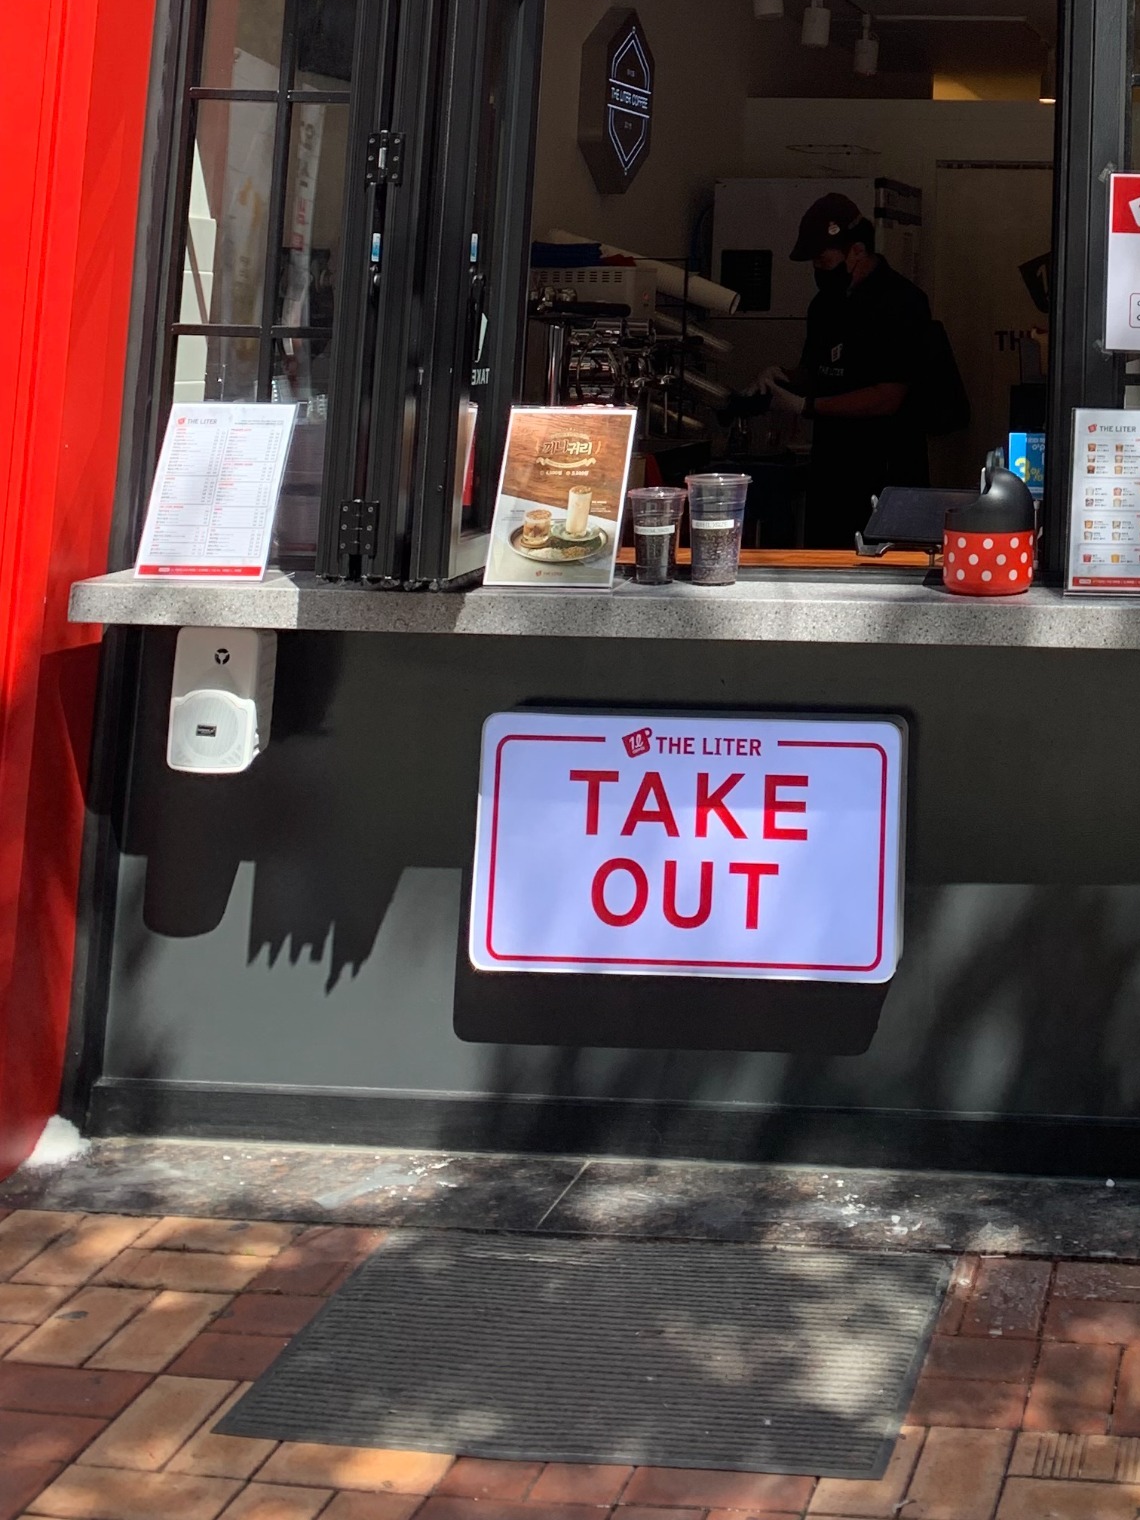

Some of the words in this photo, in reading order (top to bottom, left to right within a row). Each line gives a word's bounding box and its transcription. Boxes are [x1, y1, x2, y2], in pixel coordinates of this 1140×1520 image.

[656, 735, 695, 755] THE
[701, 737, 762, 757] LITER
[569, 769, 809, 841] TAKE
[590, 857, 780, 930] OUT
